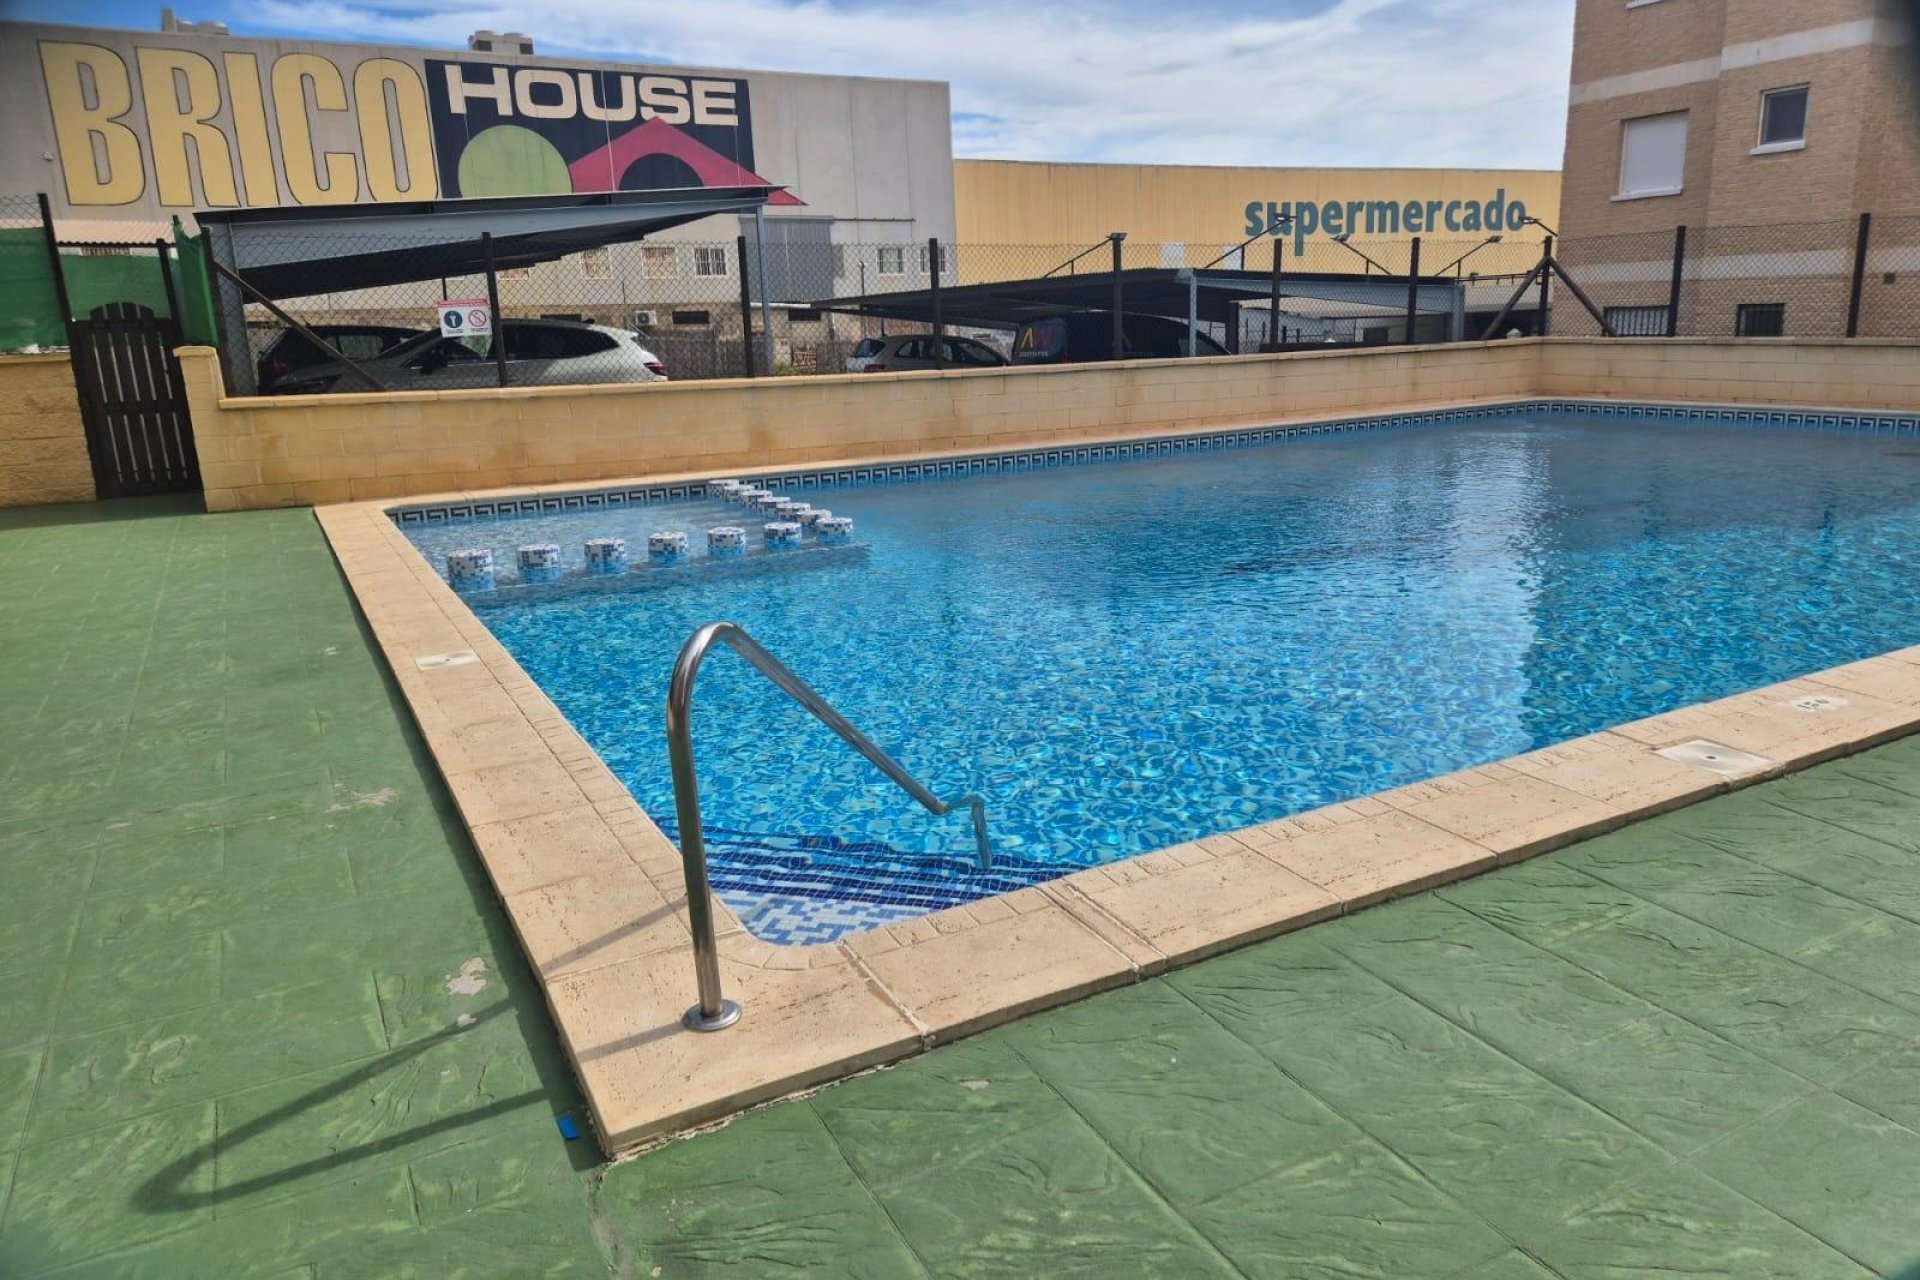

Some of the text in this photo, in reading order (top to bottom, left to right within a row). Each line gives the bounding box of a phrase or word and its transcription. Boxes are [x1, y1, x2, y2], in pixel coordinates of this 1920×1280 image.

[37, 40, 739, 208] BRICO HOUSE
[1245, 188, 1526, 256] supermercado
